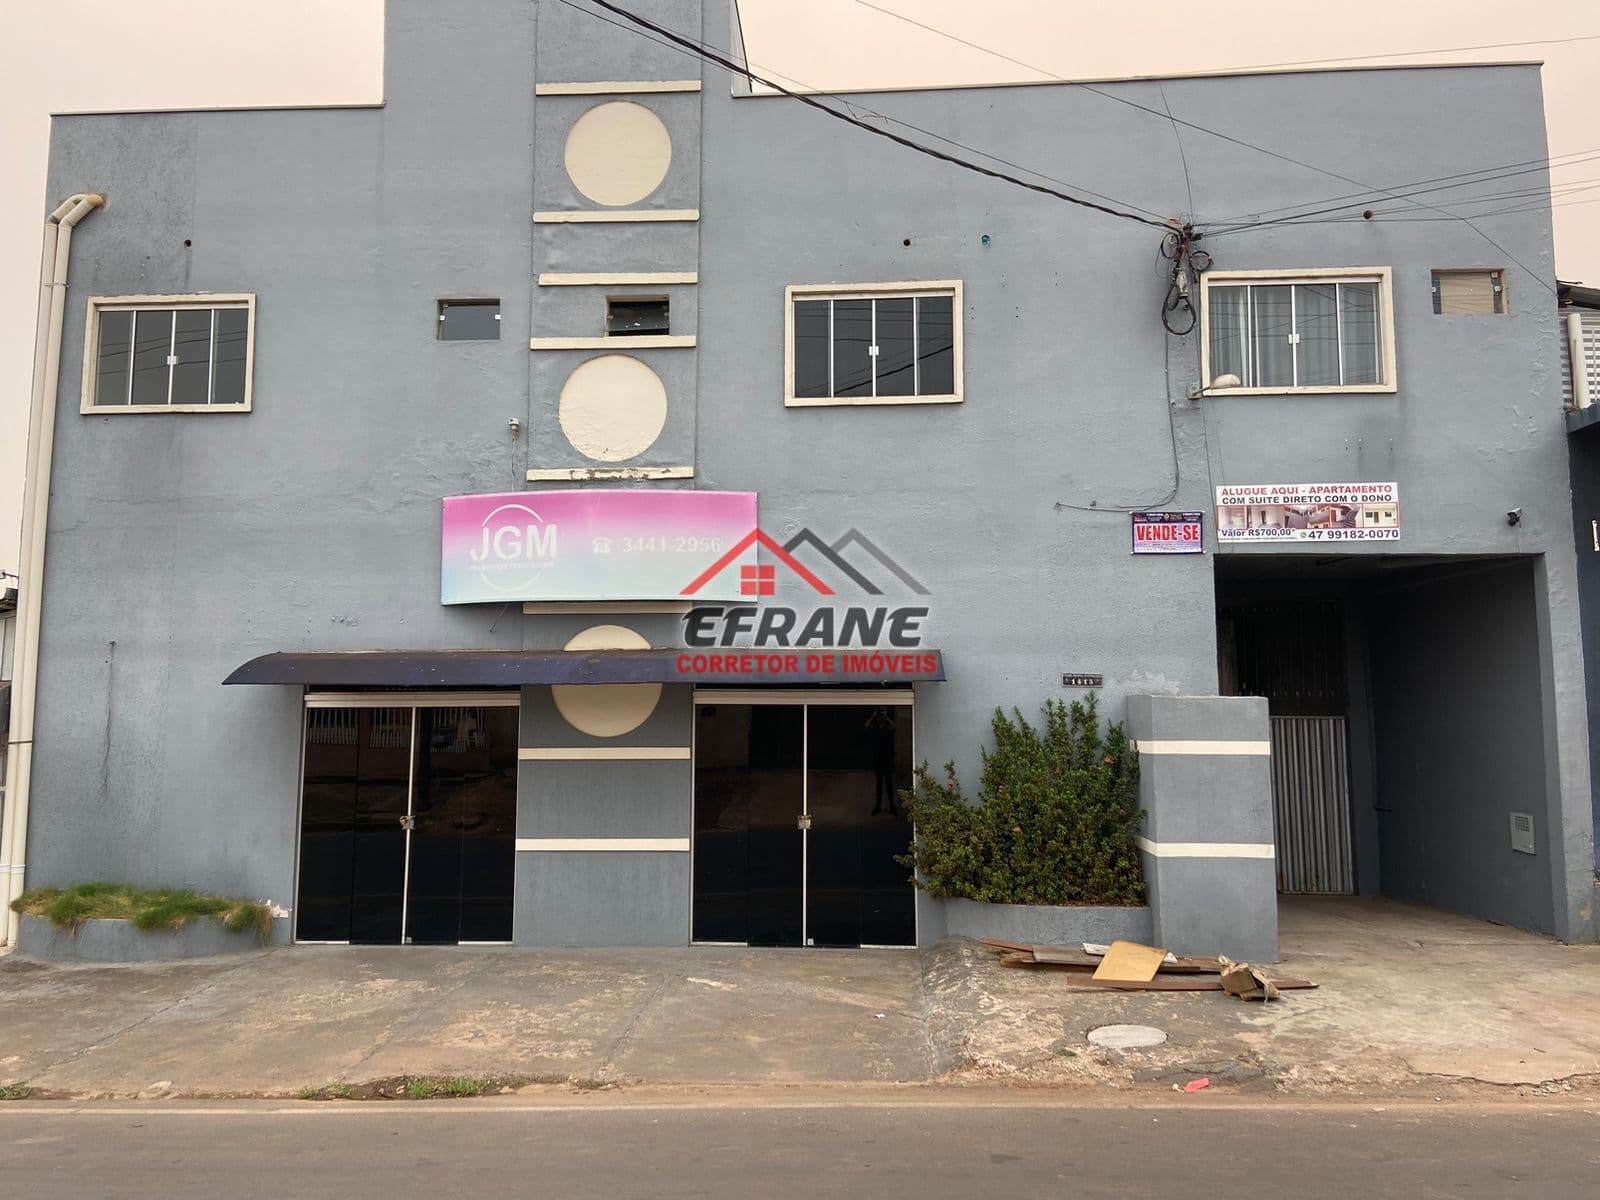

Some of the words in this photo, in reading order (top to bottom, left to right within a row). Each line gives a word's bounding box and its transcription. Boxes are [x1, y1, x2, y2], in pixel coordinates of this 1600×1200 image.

[1221, 487, 1267, 496] ALUGUE
[1270, 487, 1299, 495] AQUI
[1308, 485, 1392, 494] APARTAMENTO
[1248, 496, 1280, 504] SUITE
[1283, 495, 1322, 503] DIRETO
[1361, 494, 1392, 502] DONO
[1136, 525, 1199, 541] VENDE-SE
[1221, 529, 1246, 537] Valor
[1308, 530, 1323, 539] 47
[1327, 529, 1399, 539] 99182-0070
[470, 524, 557, 560] JGM
